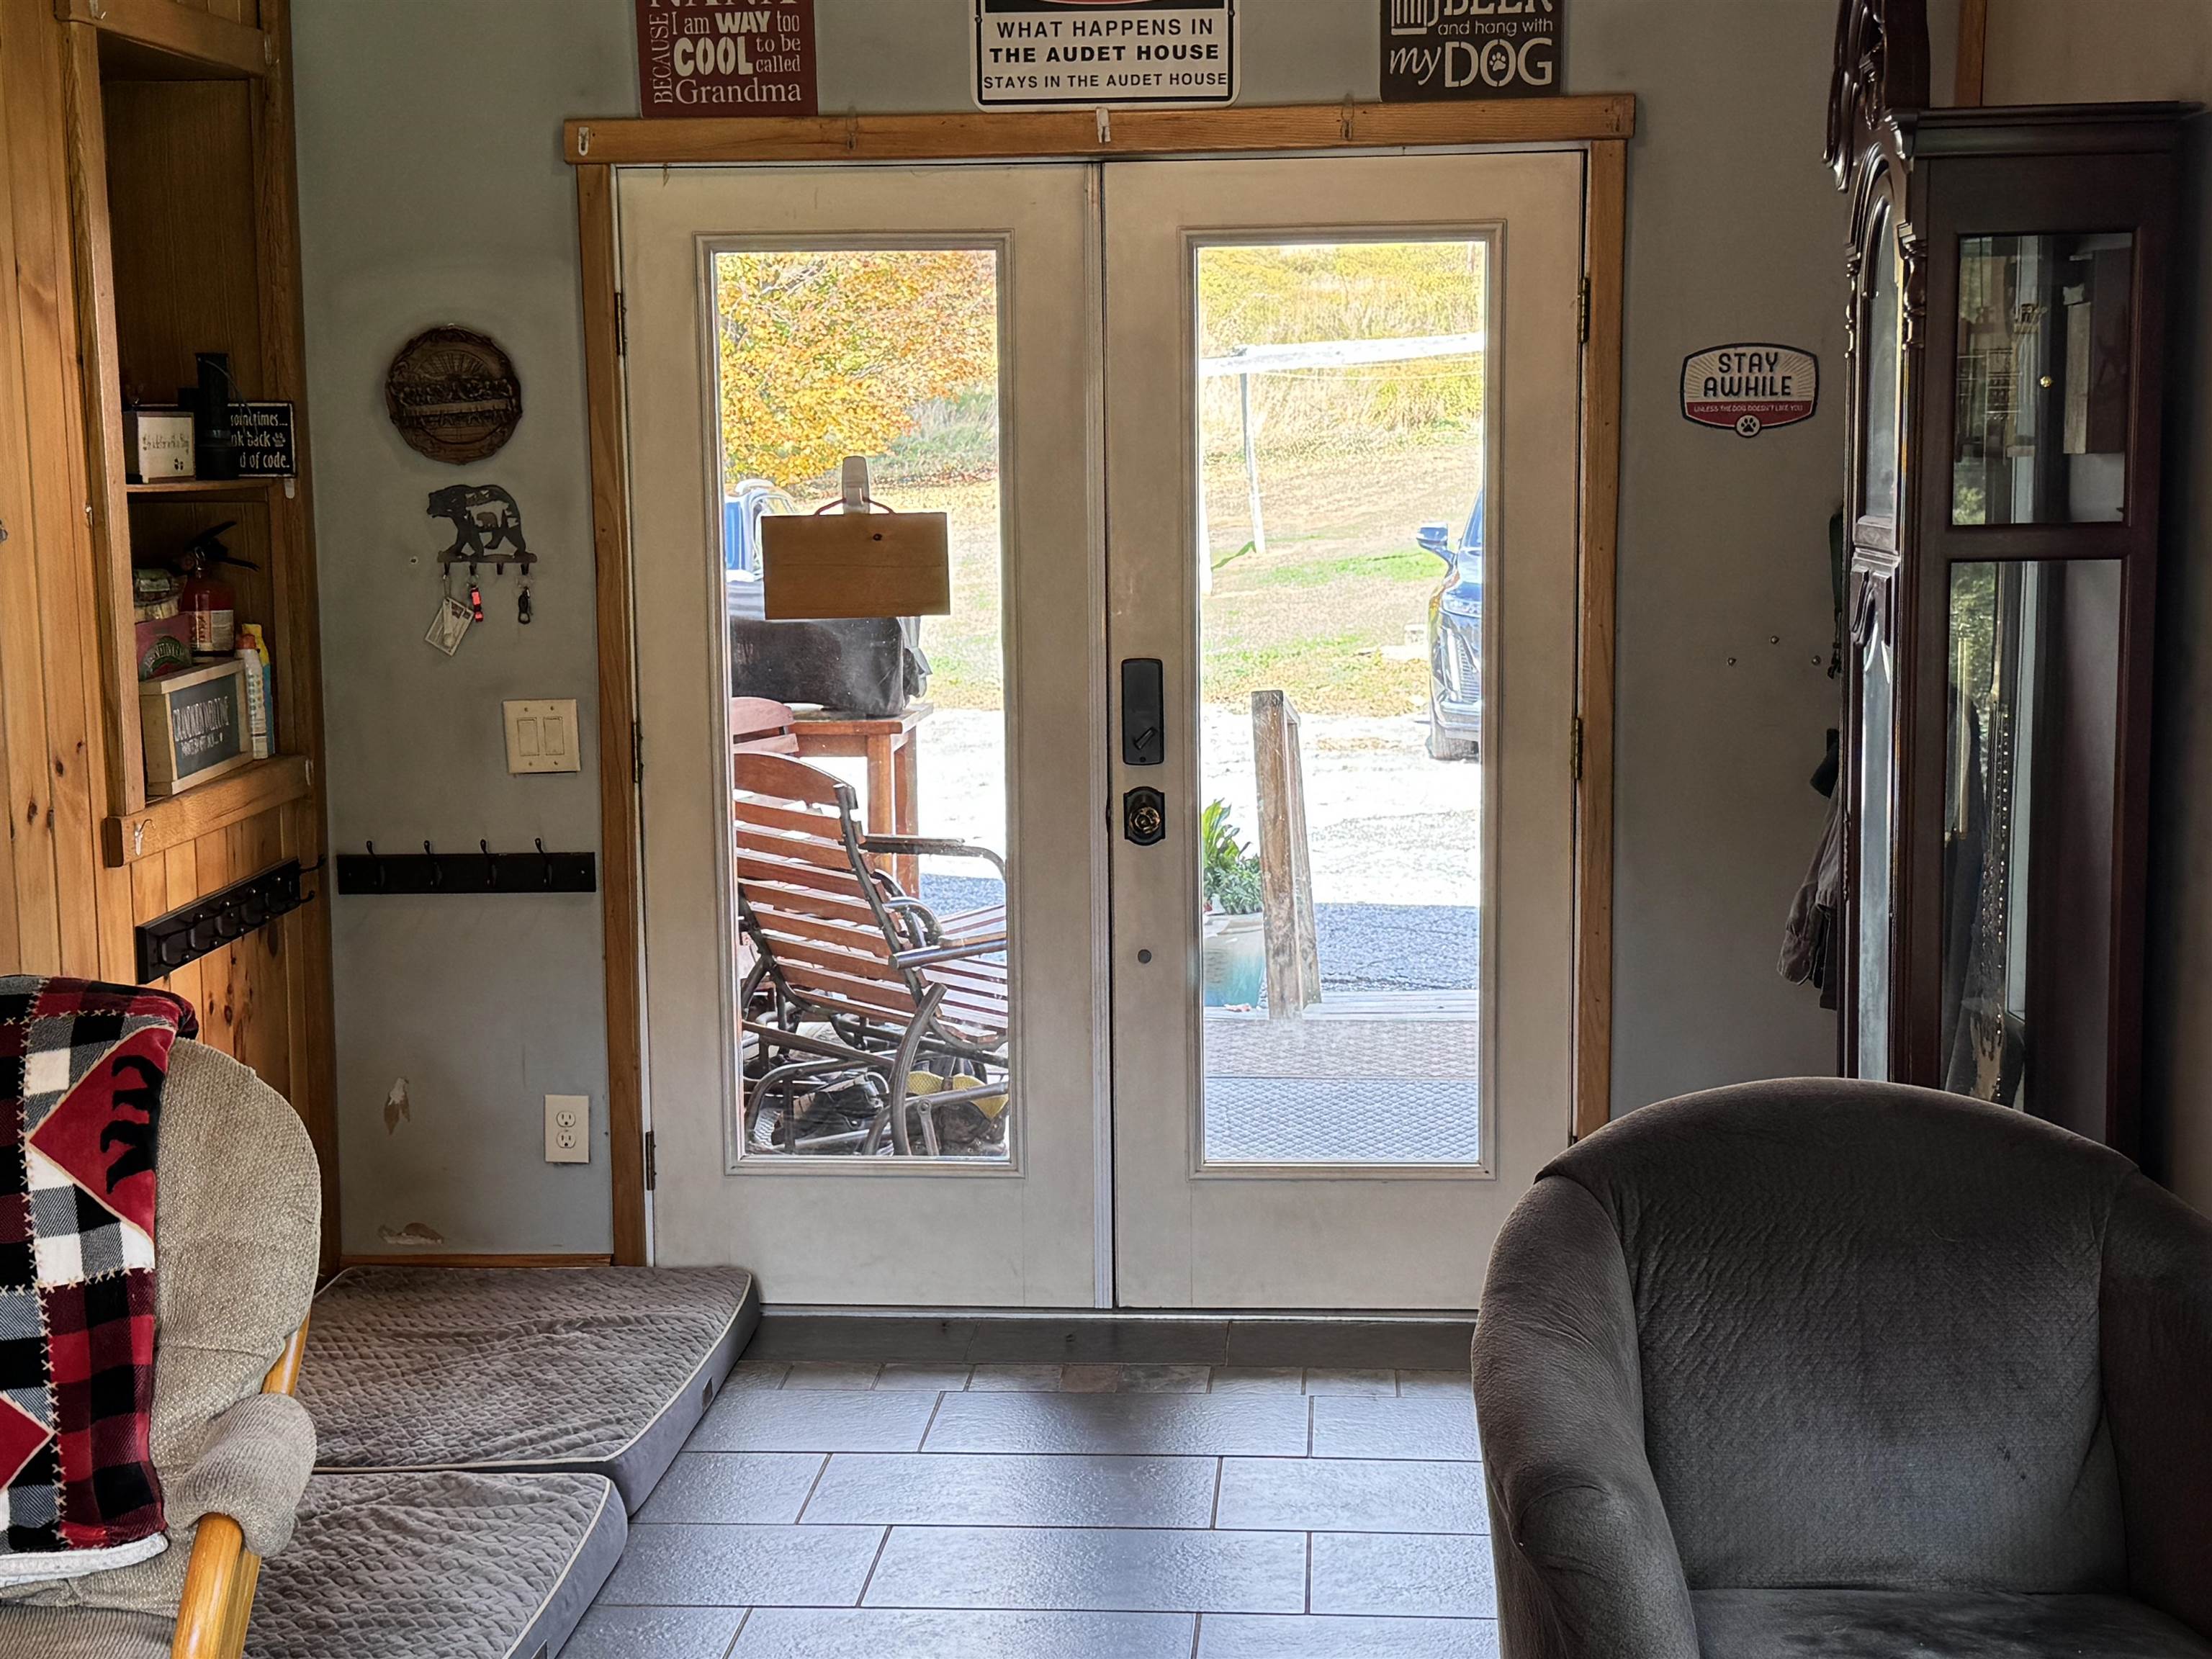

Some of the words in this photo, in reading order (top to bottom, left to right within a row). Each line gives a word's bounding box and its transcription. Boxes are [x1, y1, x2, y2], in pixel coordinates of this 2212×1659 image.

[672, 12, 678, 35] I
[684, 17, 710, 35] am
[714, 11, 771, 34] WAY
[777, 11, 800, 32] too
[997, 21, 1063, 38] WHAT
[1073, 19, 1182, 37] HAPPENS
[1191, 18, 1213, 35] IN
[1438, 20, 1470, 35] and
[1475, 20, 1517, 37] hang
[1522, 18, 1553, 32] with
[756, 37, 775, 53] to
[781, 34, 801, 51] be
[989, 47, 1036, 63] THE
[1046, 45, 1126, 62] AUDET
[1137, 44, 1219, 60] HOUSE
[649, 13, 673, 104] BECAUSE
[673, 36, 753, 76] COOL
[756, 55, 801, 73] called
[1390, 46, 1442, 86] my
[1444, 37, 1552, 88] DOG
[675, 77, 802, 104] Grandma
[984, 76, 1038, 89] STAYS
[1045, 75, 1060, 88] IN
[1067, 74, 1100, 87] THE
[1106, 73, 1163, 86] AUDET
[1169, 72, 1227, 86] HOUSE
[1718, 352, 1778, 373] STAY
[1704, 376, 1791, 397] AWHILE
